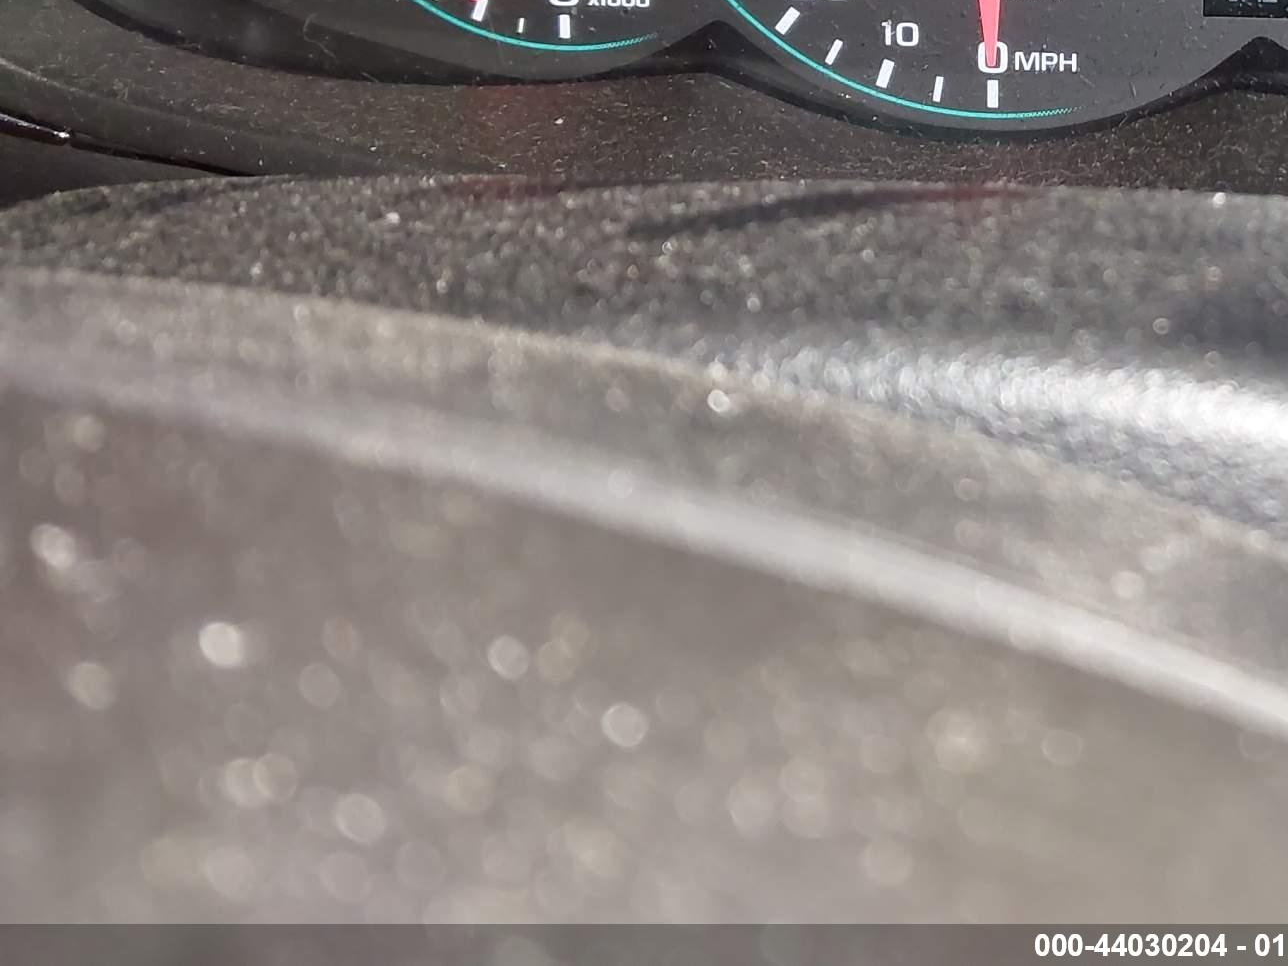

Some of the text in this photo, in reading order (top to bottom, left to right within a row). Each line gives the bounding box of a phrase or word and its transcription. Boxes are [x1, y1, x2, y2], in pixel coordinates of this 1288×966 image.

[881, 22, 919, 47] 10
[978, 41, 1077, 74] 0 MPH
